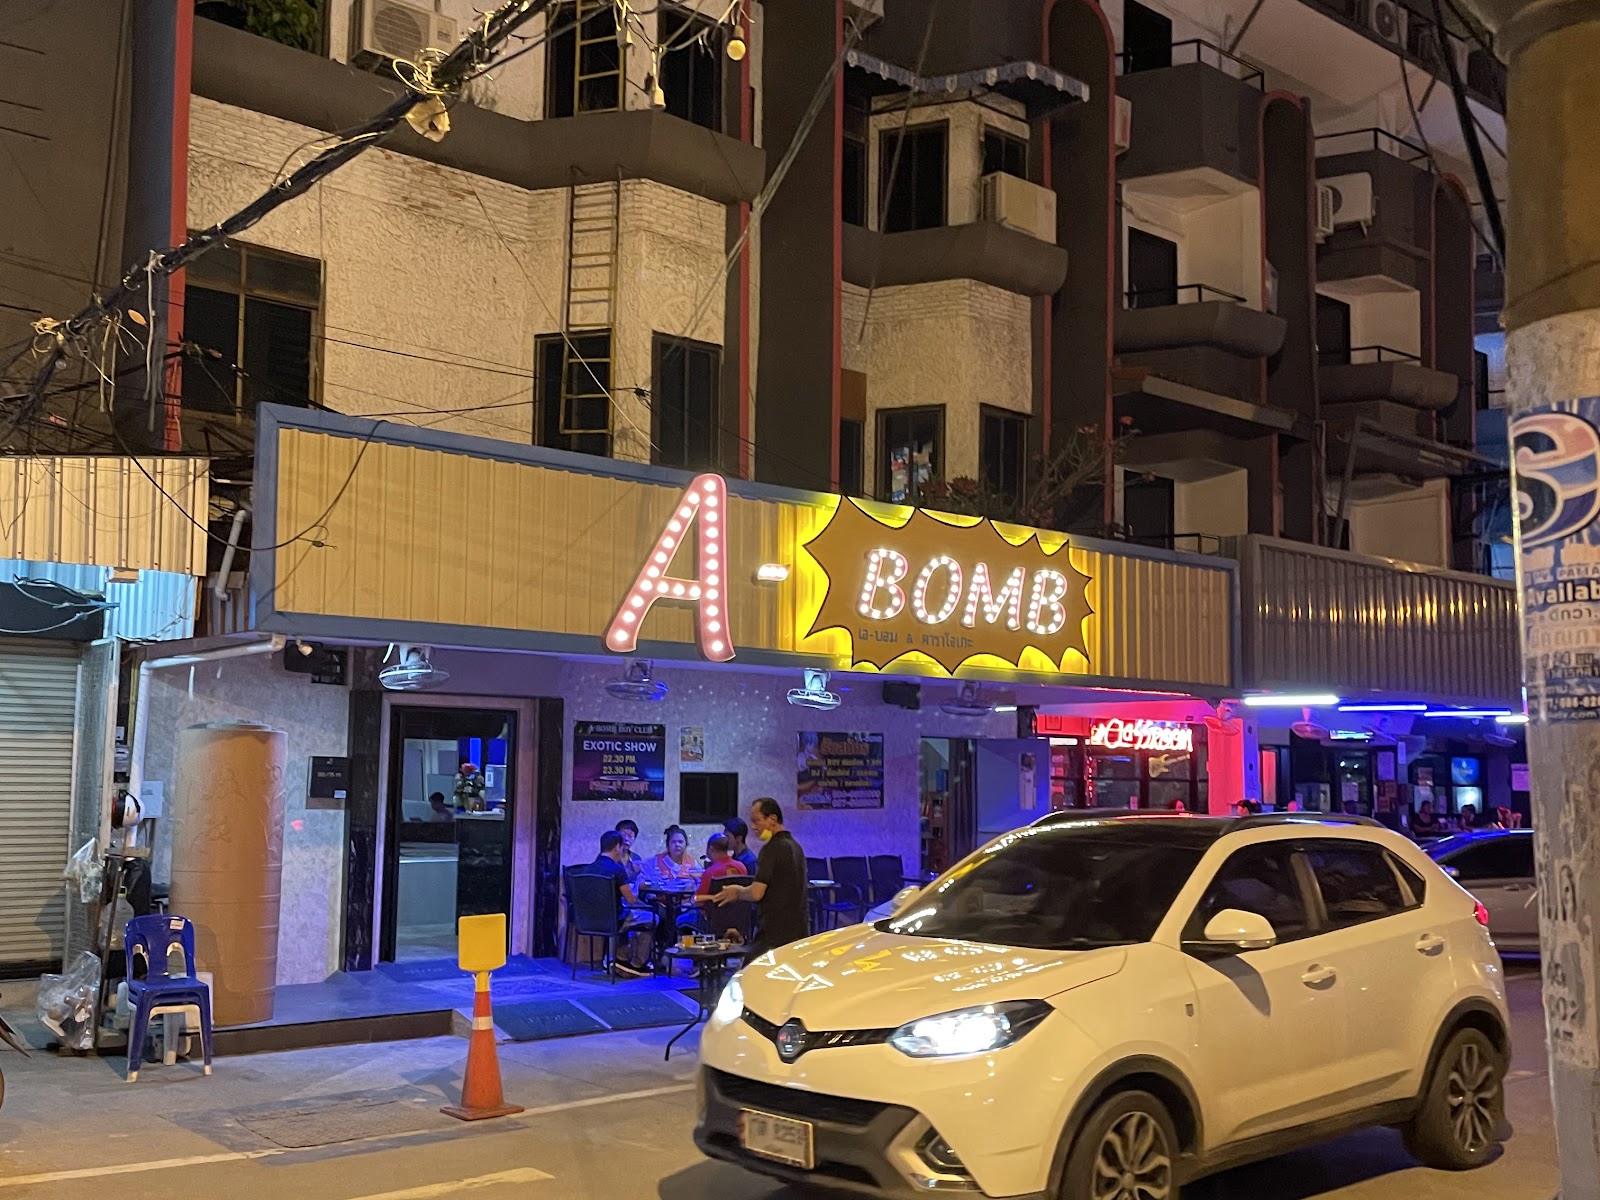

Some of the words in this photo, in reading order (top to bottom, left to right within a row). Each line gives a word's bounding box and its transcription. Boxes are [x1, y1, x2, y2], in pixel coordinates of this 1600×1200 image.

[583, 740, 622, 751] EXOTIC
[624, 742, 657, 752] SHOW
[603, 754, 624, 763] 22.30
[603, 766, 624, 774] 23.30
